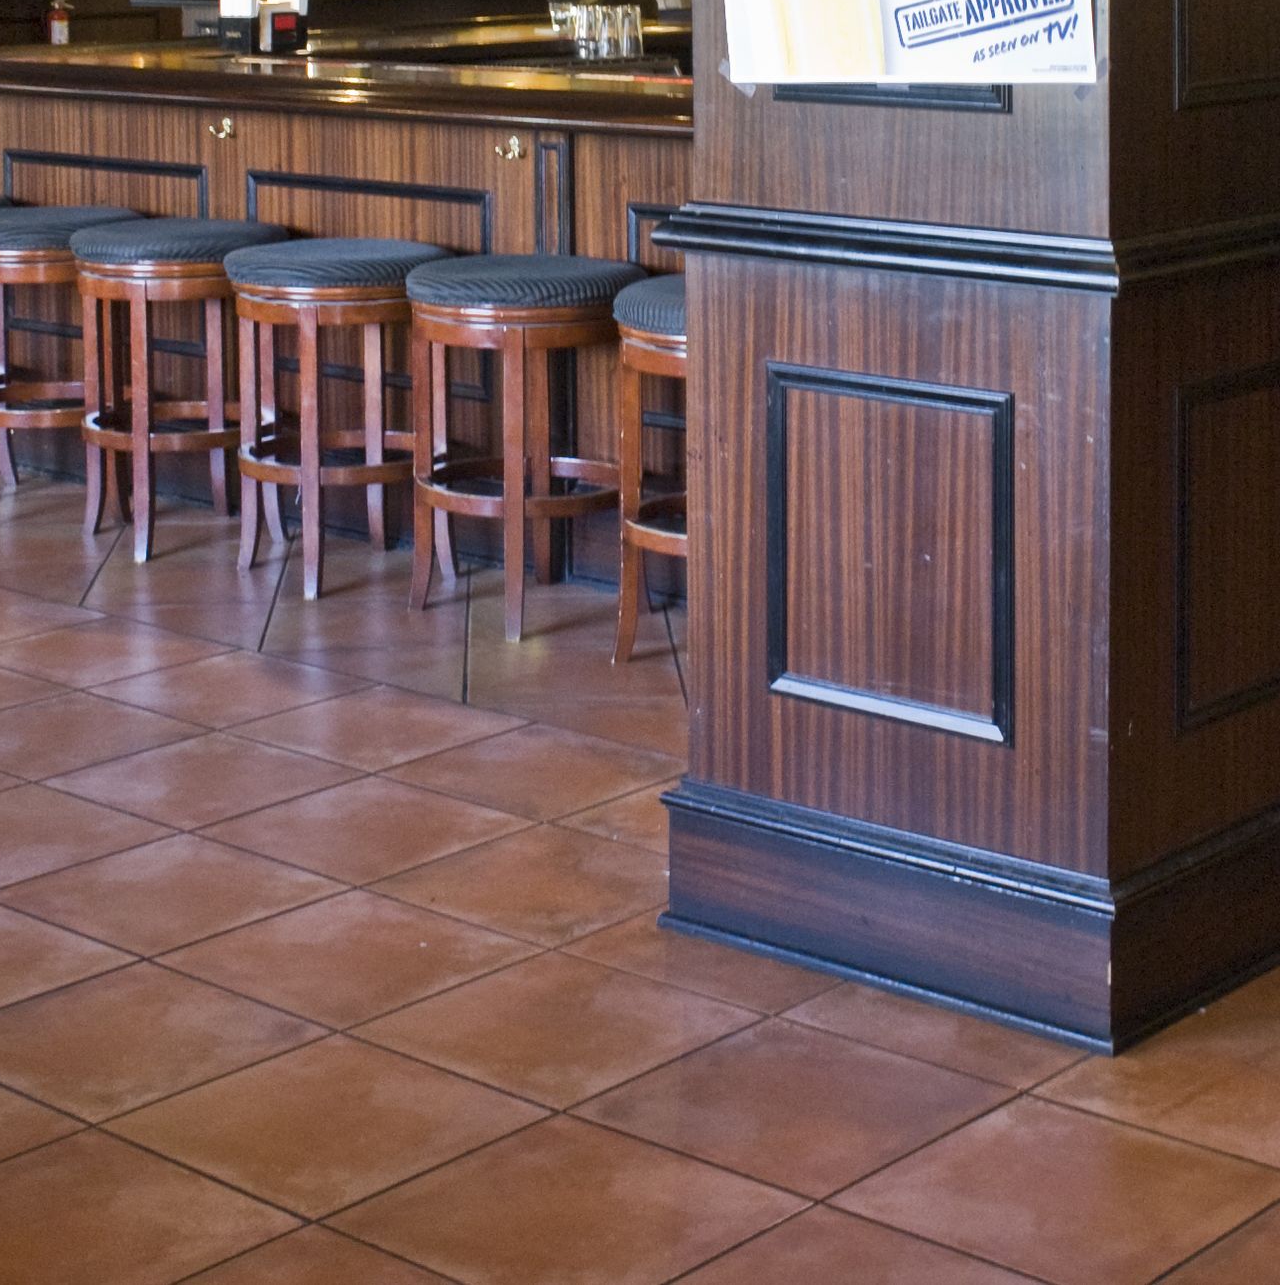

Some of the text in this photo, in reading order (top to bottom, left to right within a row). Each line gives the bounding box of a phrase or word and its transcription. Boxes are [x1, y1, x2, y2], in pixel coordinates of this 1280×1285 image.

[902, 1, 963, 33] TAILGATE
[972, 13, 1079, 64] AS SEEN ON TV!
